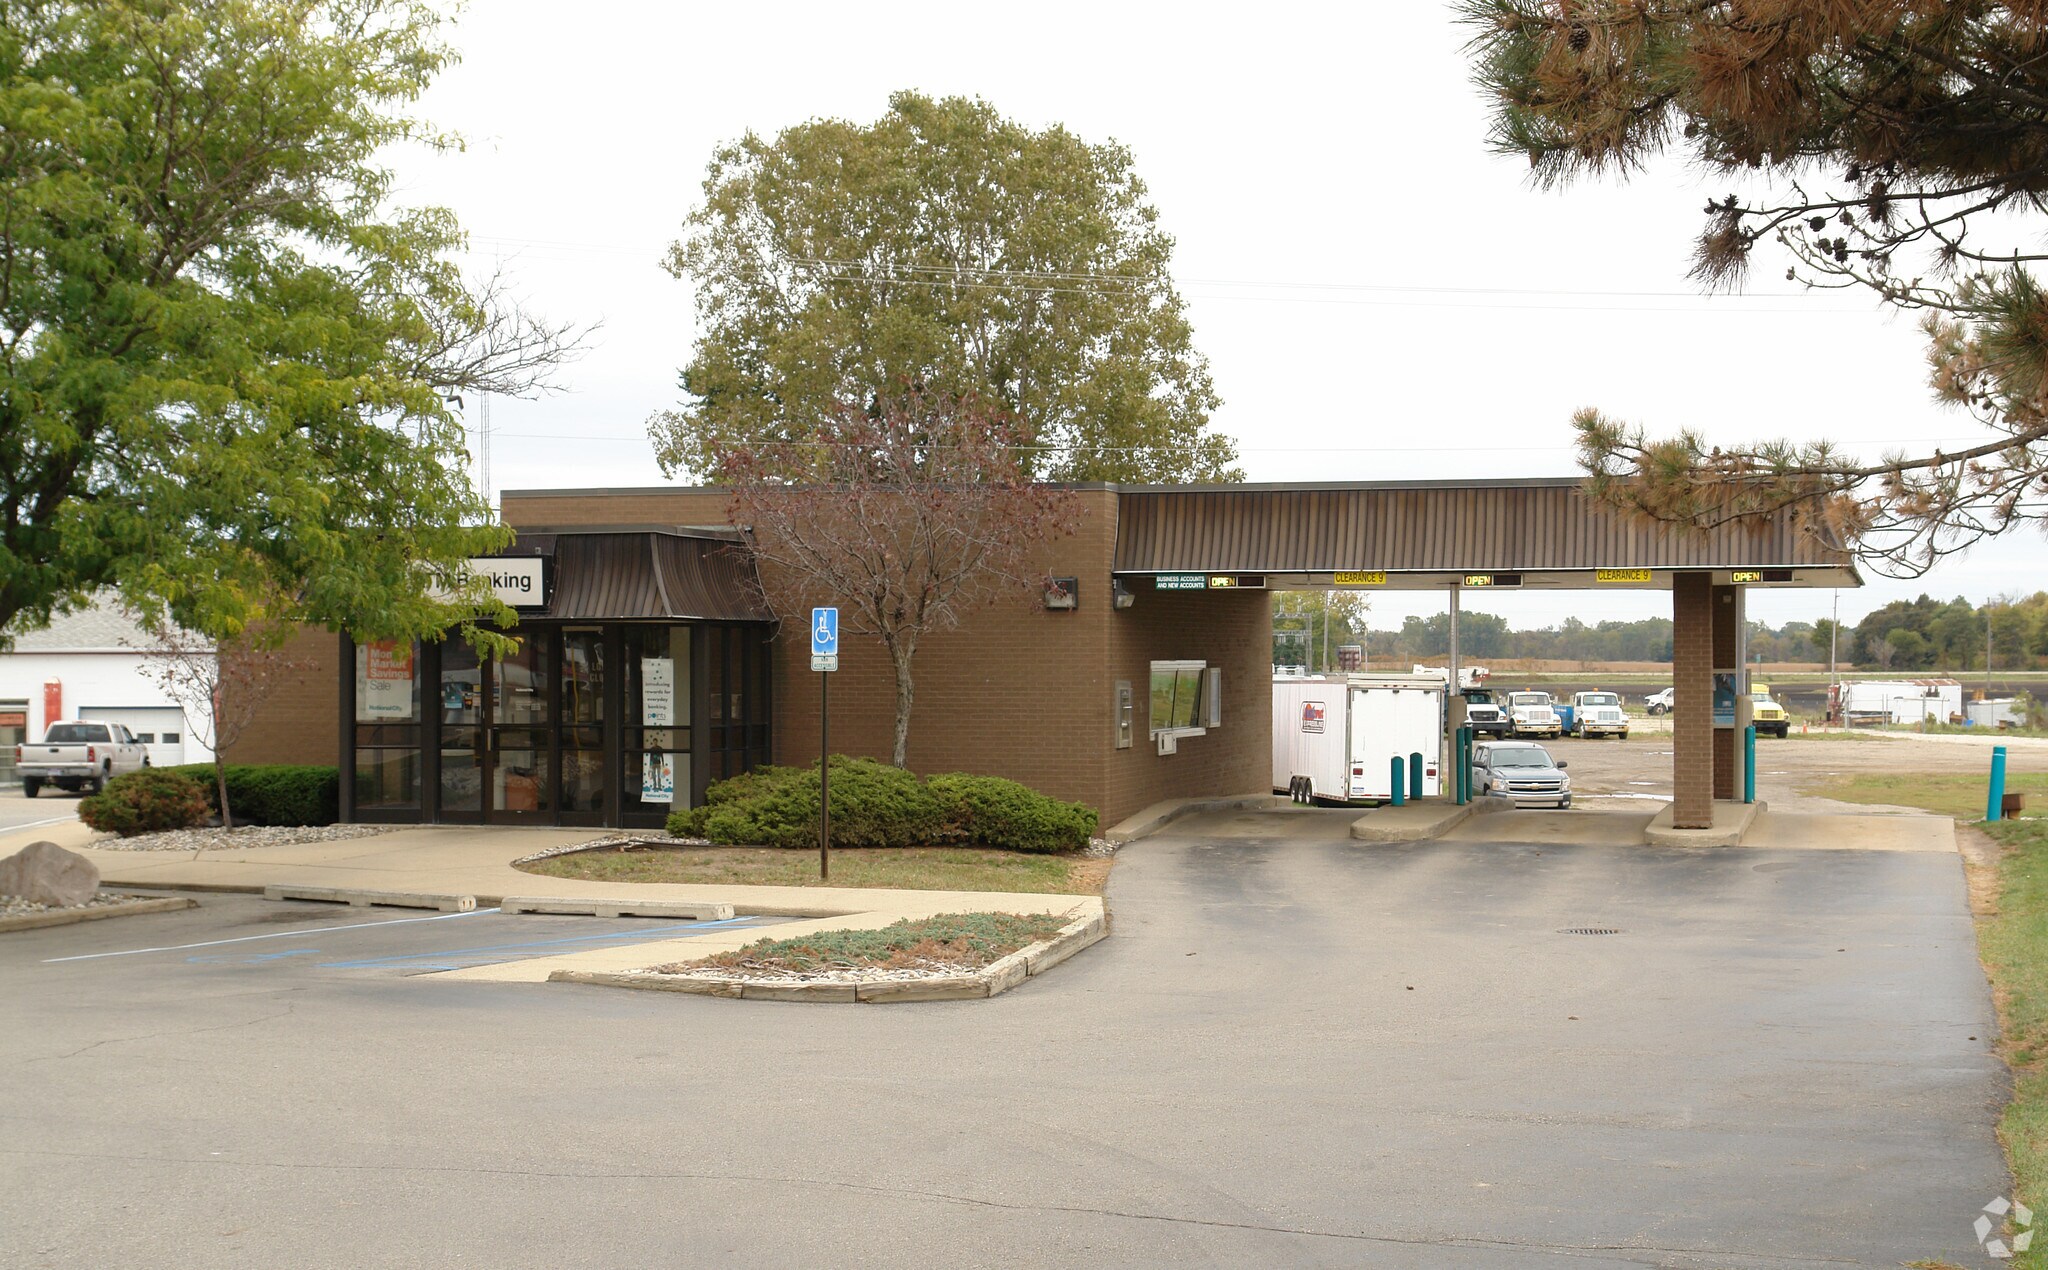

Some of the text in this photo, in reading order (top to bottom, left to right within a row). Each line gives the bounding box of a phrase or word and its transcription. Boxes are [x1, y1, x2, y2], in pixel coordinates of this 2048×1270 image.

[1335, 572, 1376, 583] CLEARANCE
[1465, 575, 1491, 585] OPEN
[1598, 569, 1641, 580] CLEARANCE
[1733, 572, 1760, 582] OPEN
[457, 572, 531, 592] Bking
[1211, 577, 1236, 587] OPEN
[371, 669, 410, 680] Savings
[370, 680, 391, 691] Sale
